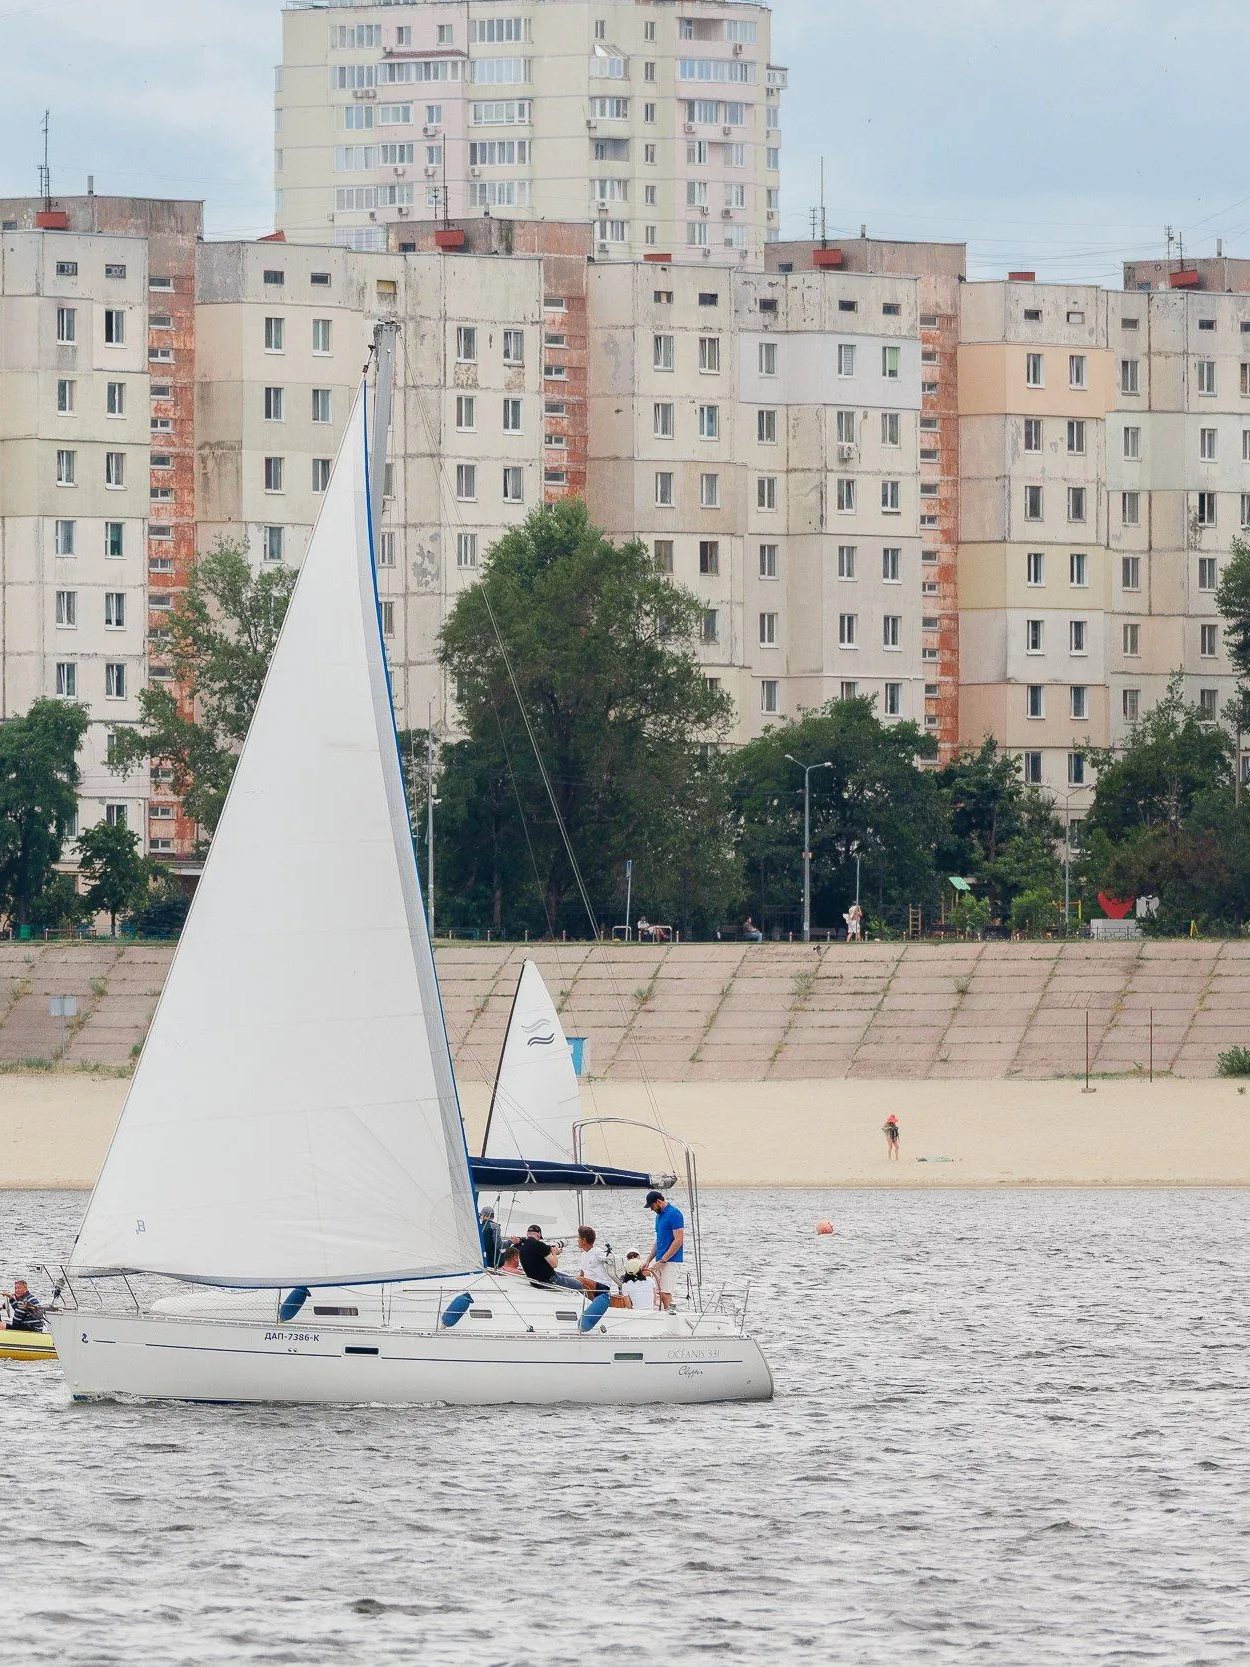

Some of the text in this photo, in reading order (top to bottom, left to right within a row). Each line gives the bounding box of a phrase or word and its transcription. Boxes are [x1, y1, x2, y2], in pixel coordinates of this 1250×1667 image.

[265, 1332, 320, 1342] ДАП-7386-К
[667, 1349, 720, 1360] OCEANIS 331
